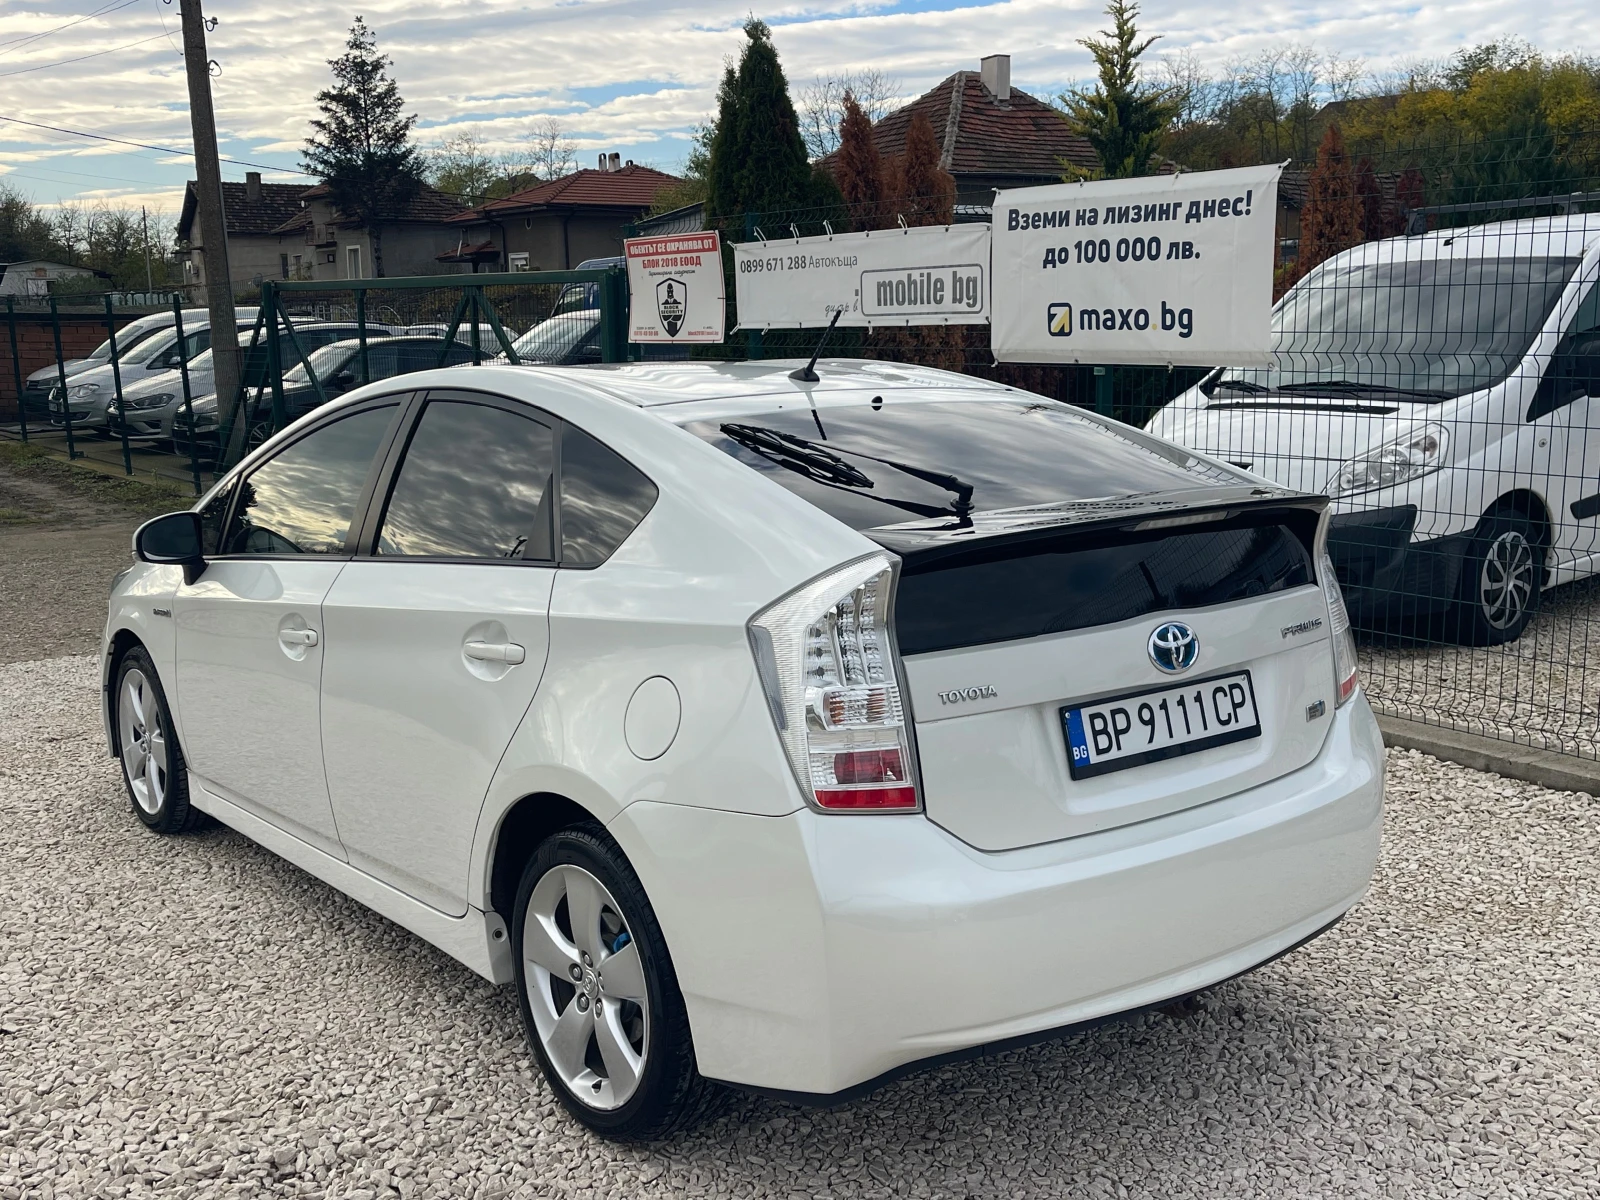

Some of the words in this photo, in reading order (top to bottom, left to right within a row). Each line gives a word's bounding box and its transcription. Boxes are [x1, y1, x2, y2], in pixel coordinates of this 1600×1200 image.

[1008, 208, 1070, 231] Вземи
[1075, 207, 1098, 226] на
[1103, 202, 1182, 225] лизинг
[1185, 190, 1253, 224] днес!
[630, 243, 657, 255] ОБЕКТЪТ
[657, 243, 666, 253] СЕ
[666, 240, 703, 252] ОХРАНЯВА
[703, 239, 713, 249] ОТ
[1043, 246, 1069, 269] до
[1074, 239, 1110, 264] 100
[1116, 236, 1161, 262] 000
[1166, 241, 1201, 260] лв.
[661, 257, 678, 268] 2018
[680, 255, 702, 267] ЕООД
[740, 258, 764, 274] 0899
[766, 257, 784, 271] 671
[787, 255, 807, 270] 288
[808, 254, 858, 269] Автокъща
[876, 272, 945, 307] mobile
[952, 271, 977, 308] bg
[1079, 301, 1193, 339] maxo.bg
[1280, 618, 1322, 639] PRIUS
[938, 685, 997, 706] TOYOTA
[1139, 690, 1208, 745] 9111
[1073, 745, 1088, 760] BG
